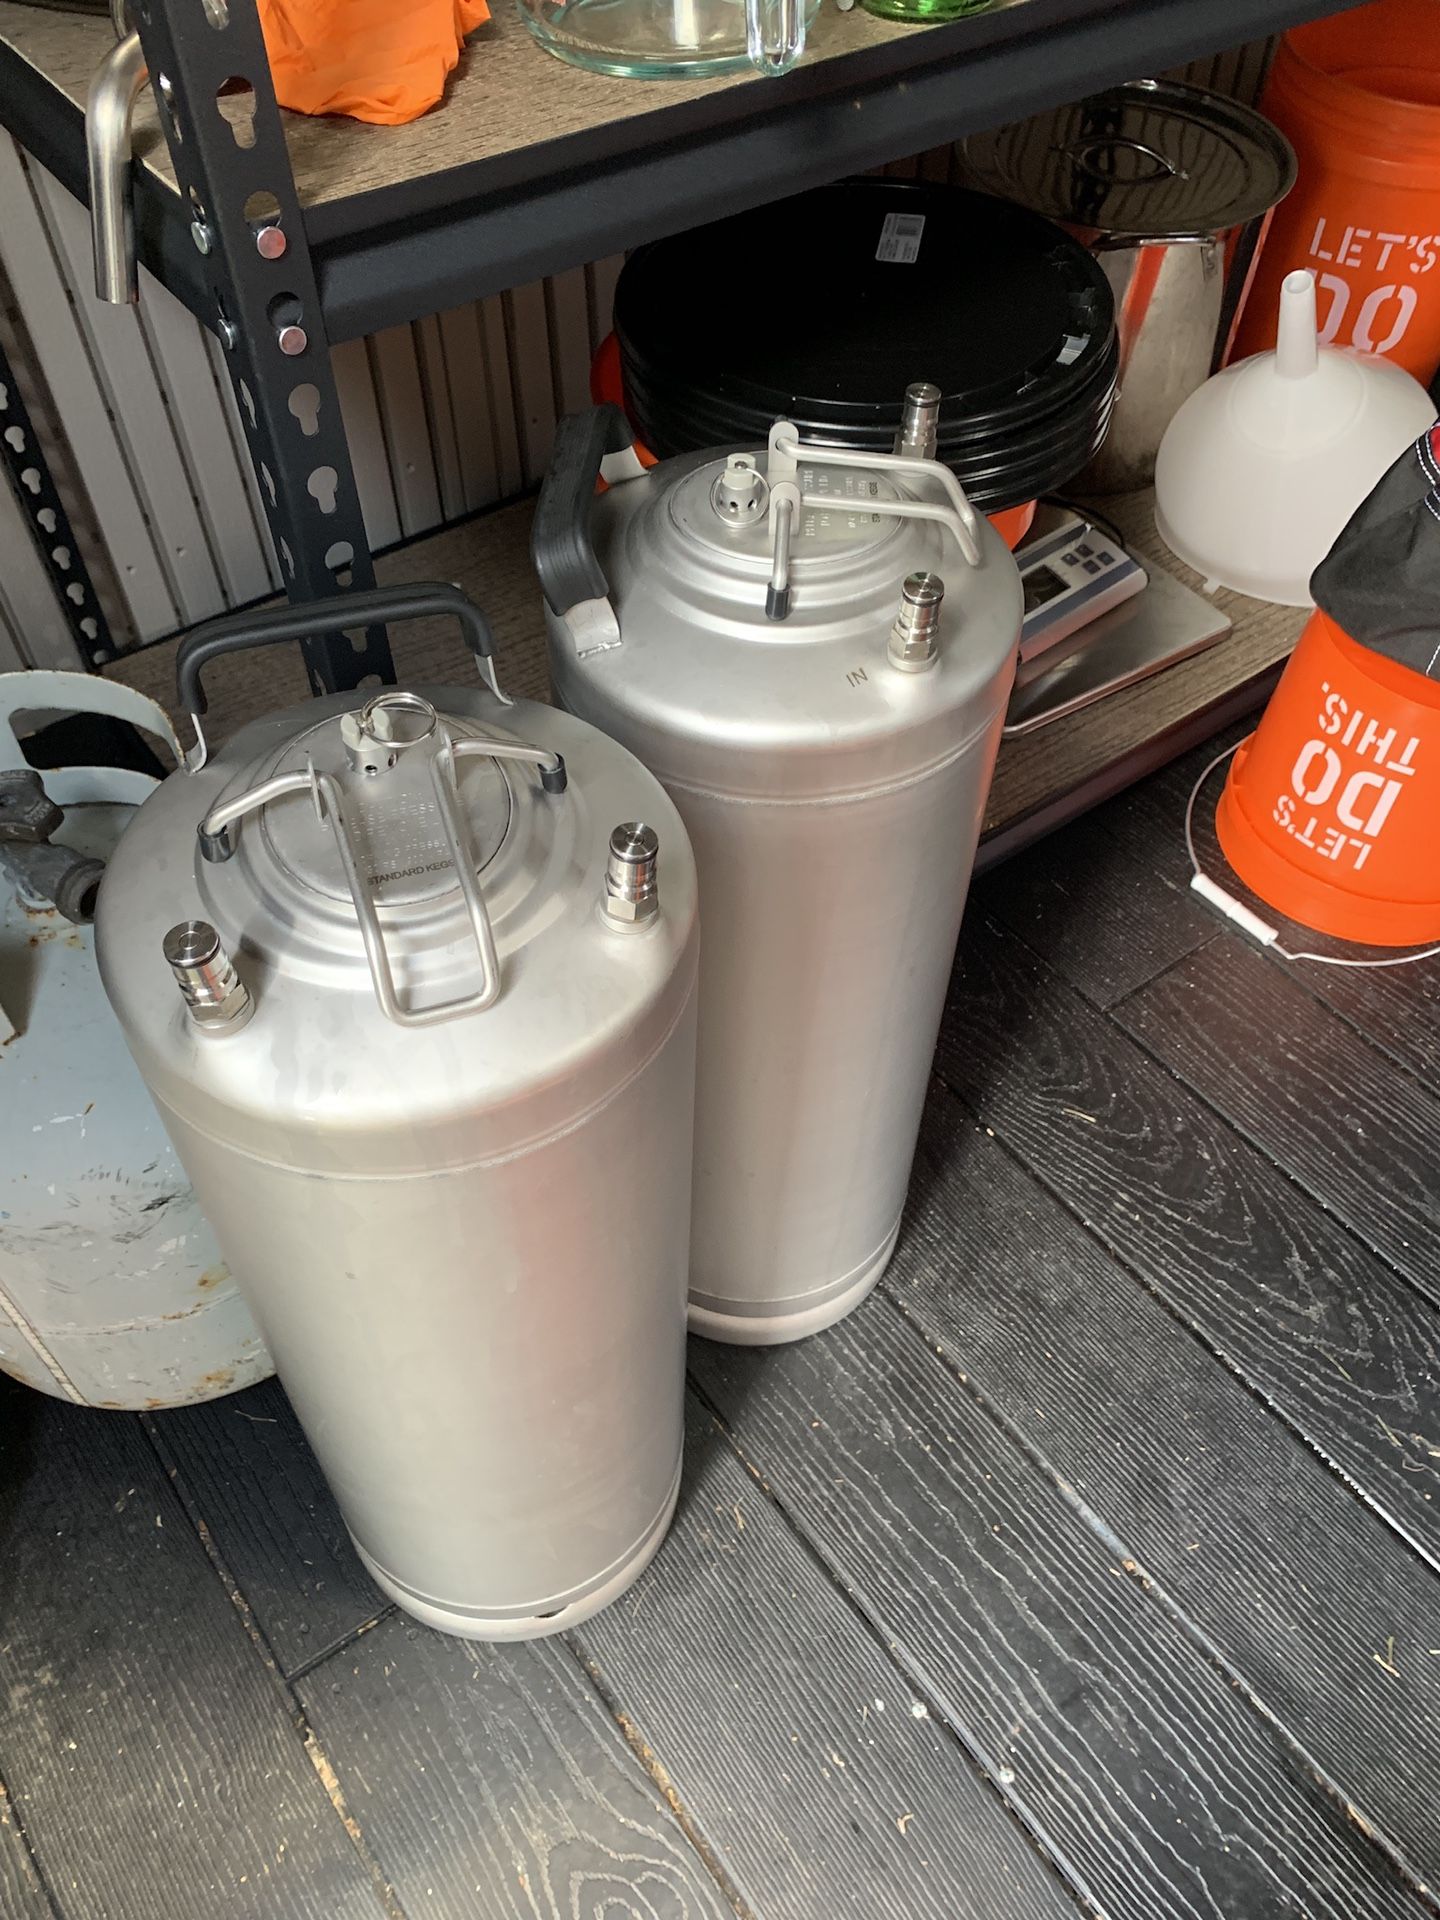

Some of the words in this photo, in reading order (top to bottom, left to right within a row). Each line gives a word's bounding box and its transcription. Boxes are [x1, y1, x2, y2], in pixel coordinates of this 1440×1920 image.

[1309, 217, 1440, 274] LET'S
[1304, 267, 1418, 354] DO
[846, 667, 868, 688] IN
[1318, 681, 1420, 776] THIS.
[1291, 739, 1403, 838] DO
[1273, 795, 1372, 870] LET'S
[366, 866, 425, 886] STANDARD
